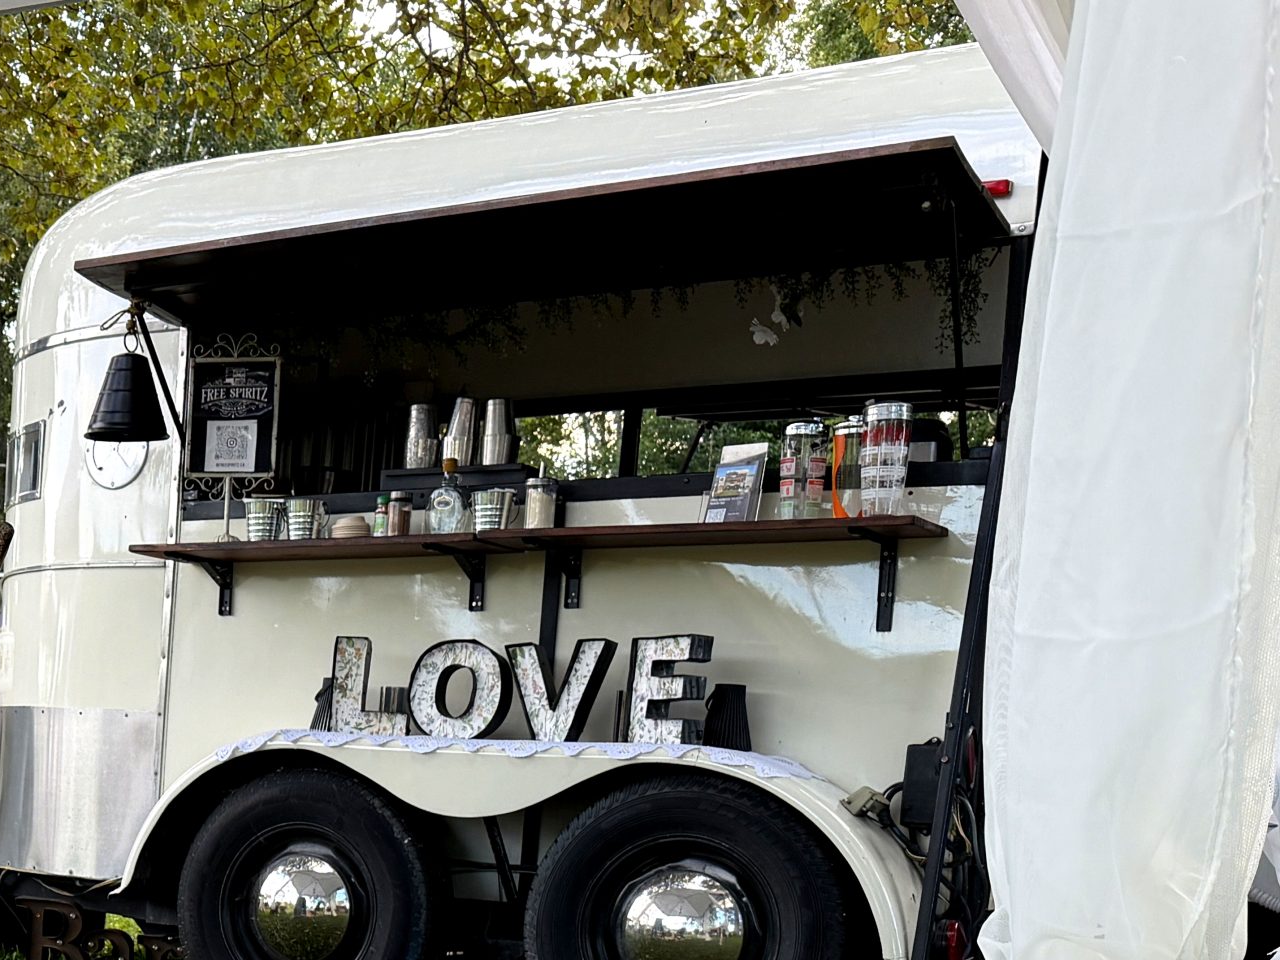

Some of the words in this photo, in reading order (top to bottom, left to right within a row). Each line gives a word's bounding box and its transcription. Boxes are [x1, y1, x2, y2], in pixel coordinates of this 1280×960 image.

[201, 388, 227, 403] FREE
[229, 386, 268, 402] SPIRITZ
[331, 634, 714, 745] LOVE
